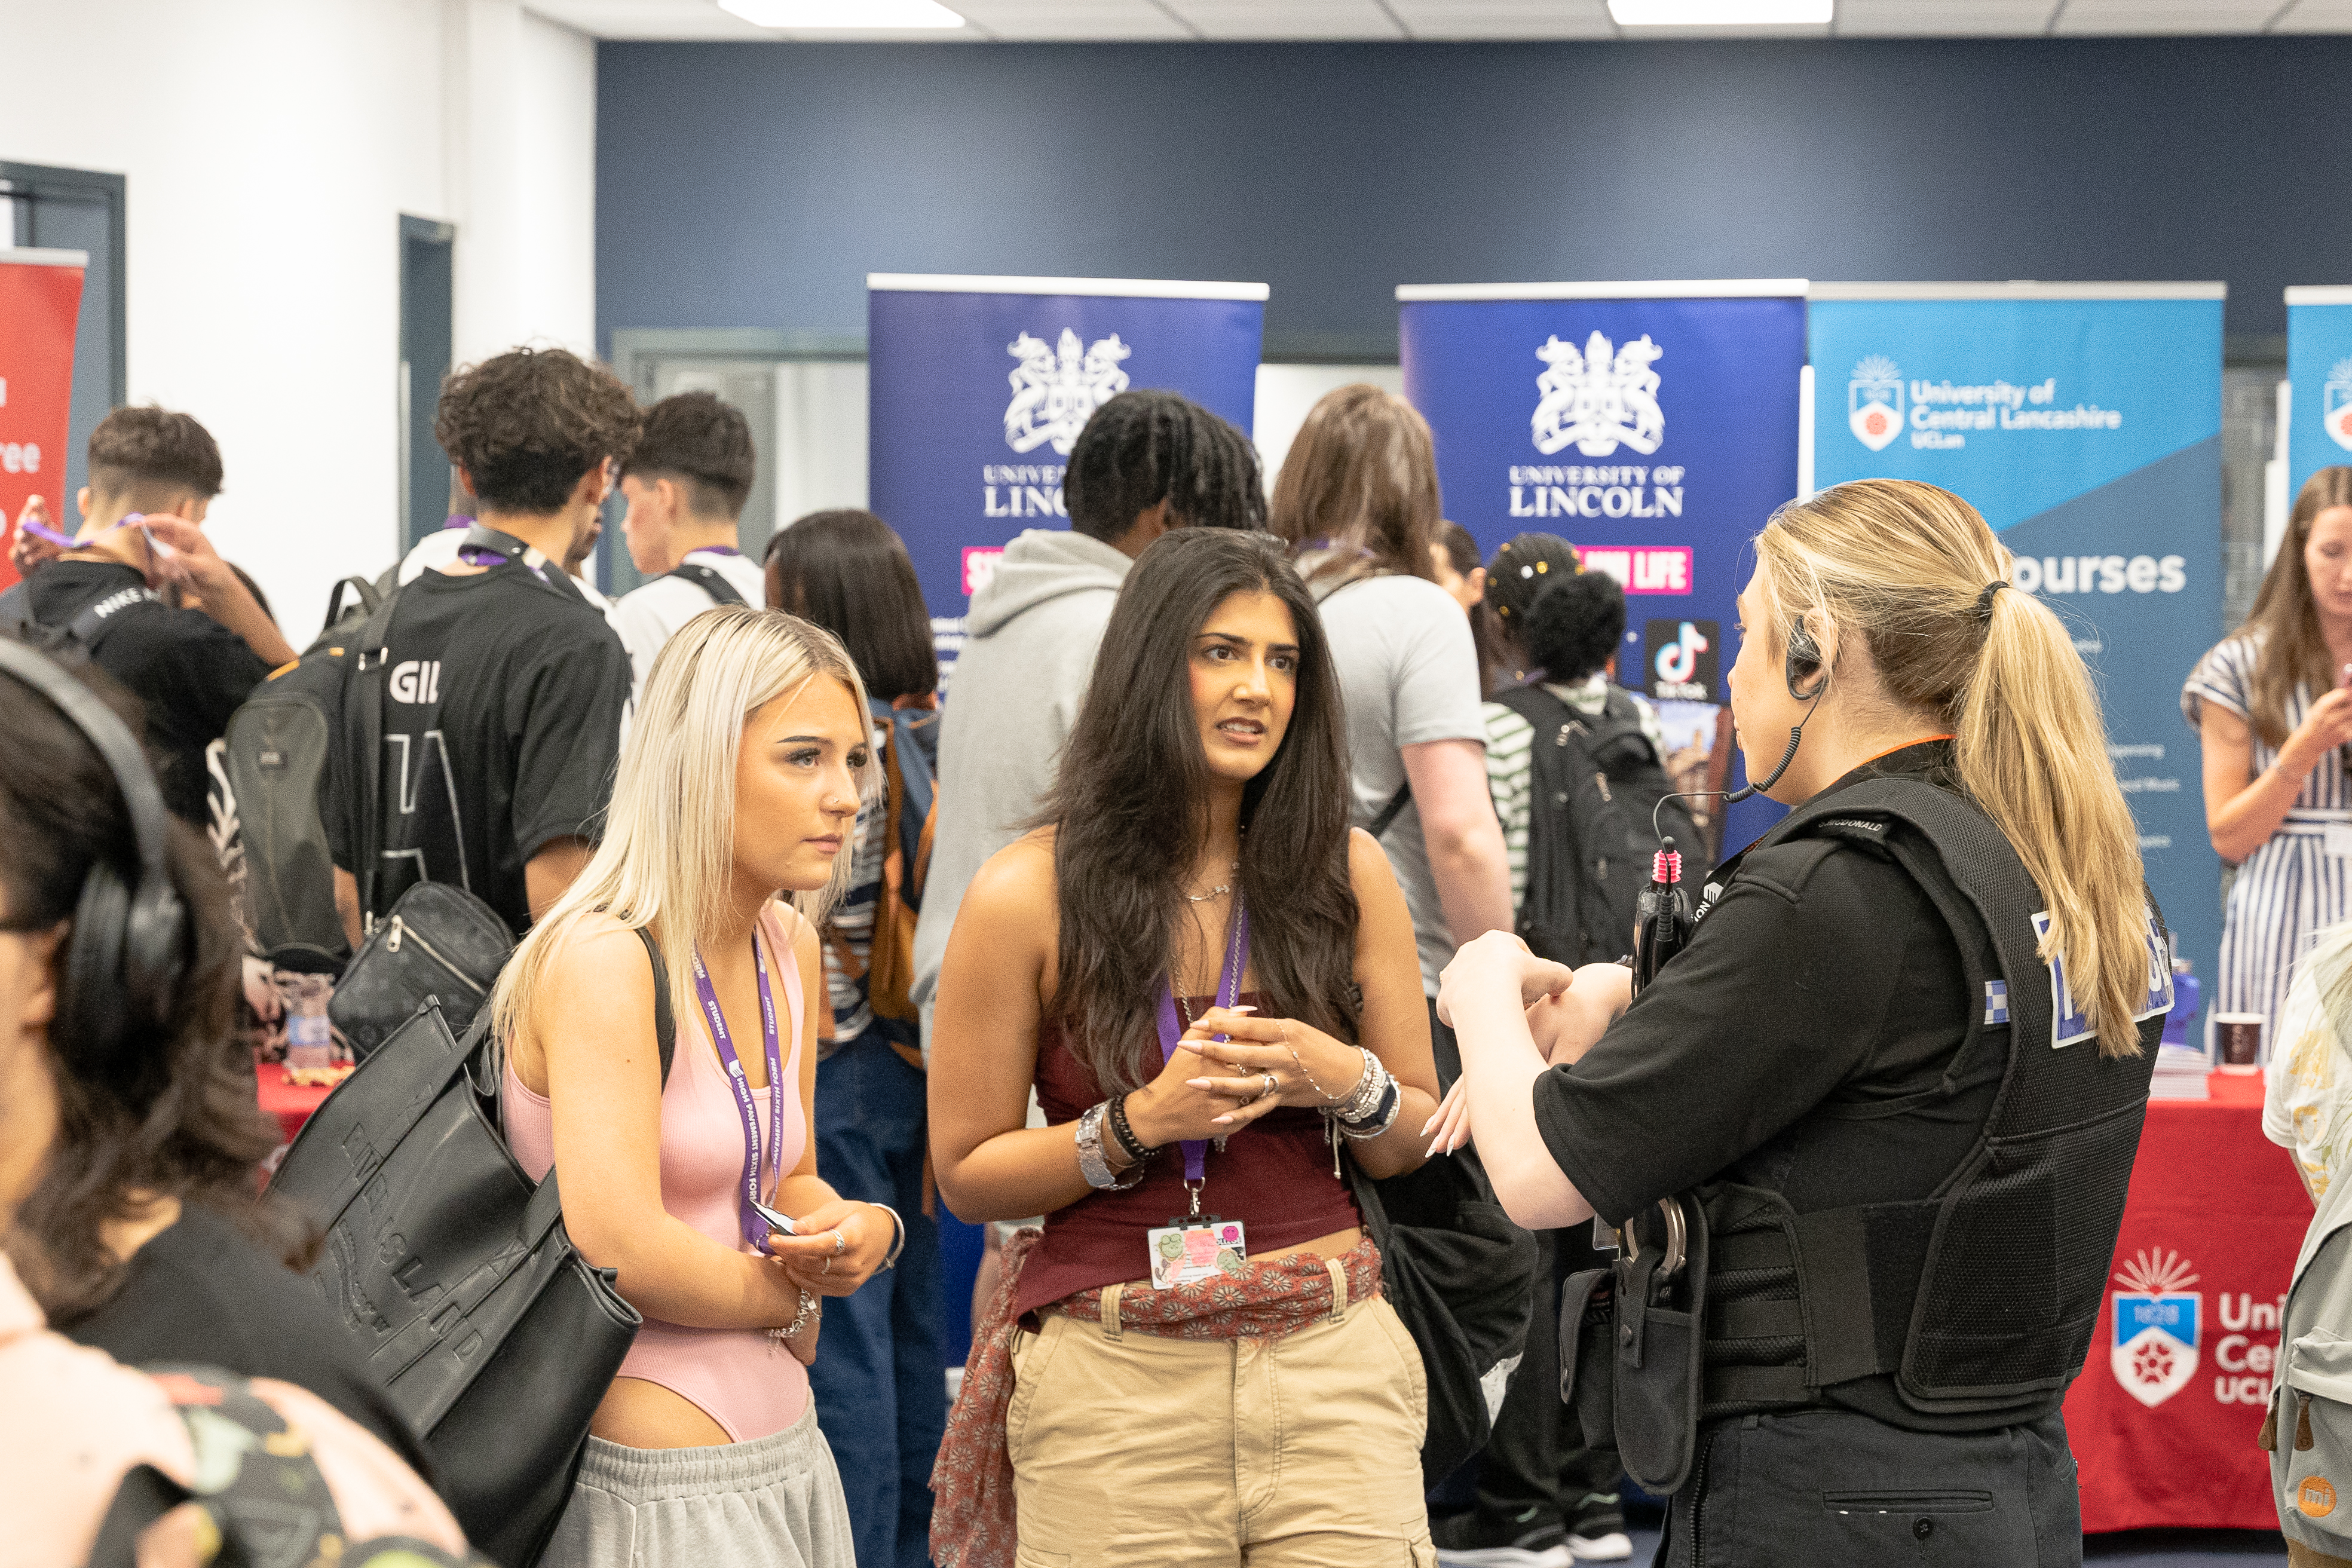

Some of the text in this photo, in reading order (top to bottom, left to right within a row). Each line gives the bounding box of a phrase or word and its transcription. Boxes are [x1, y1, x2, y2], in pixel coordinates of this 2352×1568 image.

[1911, 379, 2026, 410] University
[2028, 378, 2056, 405] of
[1910, 403, 2121, 430] Central Lancashire
[1509, 465, 1686, 486] UNIVERSITY OF
[1509, 486, 1684, 518] LINCOLN
[1633, 551, 1687, 590] LIFE
[2013, 555, 2186, 593] ourses
[708, 1000, 726, 1039] STUDENT
[764, 995, 775, 1036] STUDENT
[770, 1056, 779, 1085] FORM
[736, 1076, 751, 1103] HIGH
[745, 1104, 759, 1151] PAVEMENT
[773, 1116, 781, 1165] PAVEMENT
[749, 1152, 760, 1177] SIXTH
[2215, 1334, 2278, 1373] Ce
[2305, 1488, 2330, 1506] mi
